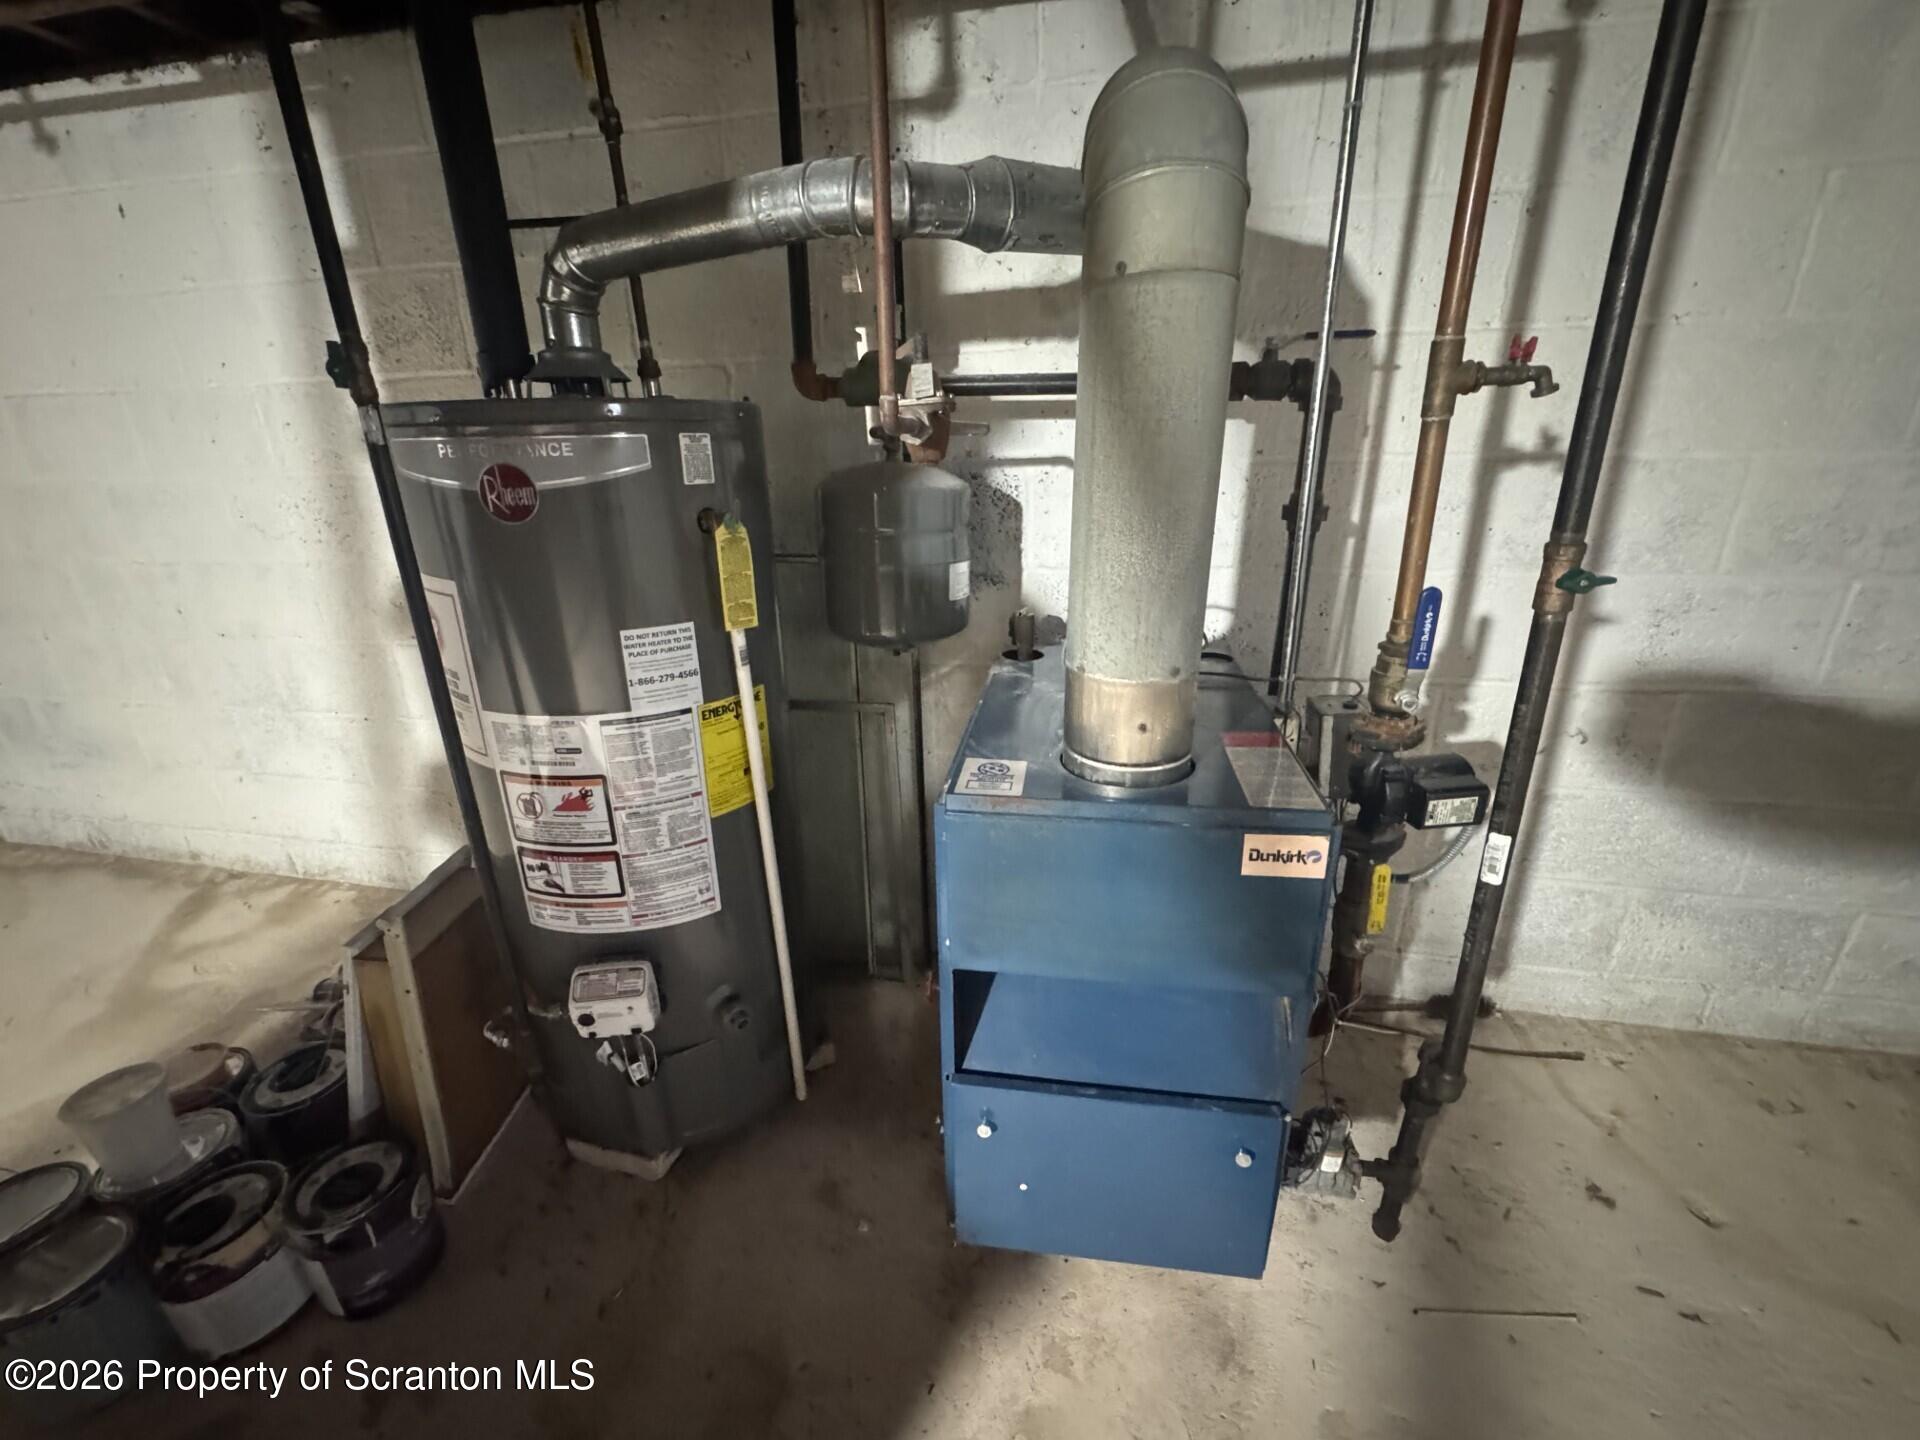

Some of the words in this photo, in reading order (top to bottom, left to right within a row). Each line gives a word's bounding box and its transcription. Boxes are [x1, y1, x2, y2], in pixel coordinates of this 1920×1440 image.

[436, 442, 574, 459] PEFOANCE
[483, 464, 536, 514] Rheem
[652, 629, 677, 638] RETURN
[624, 642, 646, 650] WATER
[648, 639, 672, 647] HEATER
[628, 650, 648, 658] PLACE
[660, 644, 692, 654] PURCHASE
[629, 668, 699, 687] 1-866-279-4566
[1248, 847, 1307, 865] Dunkirk
